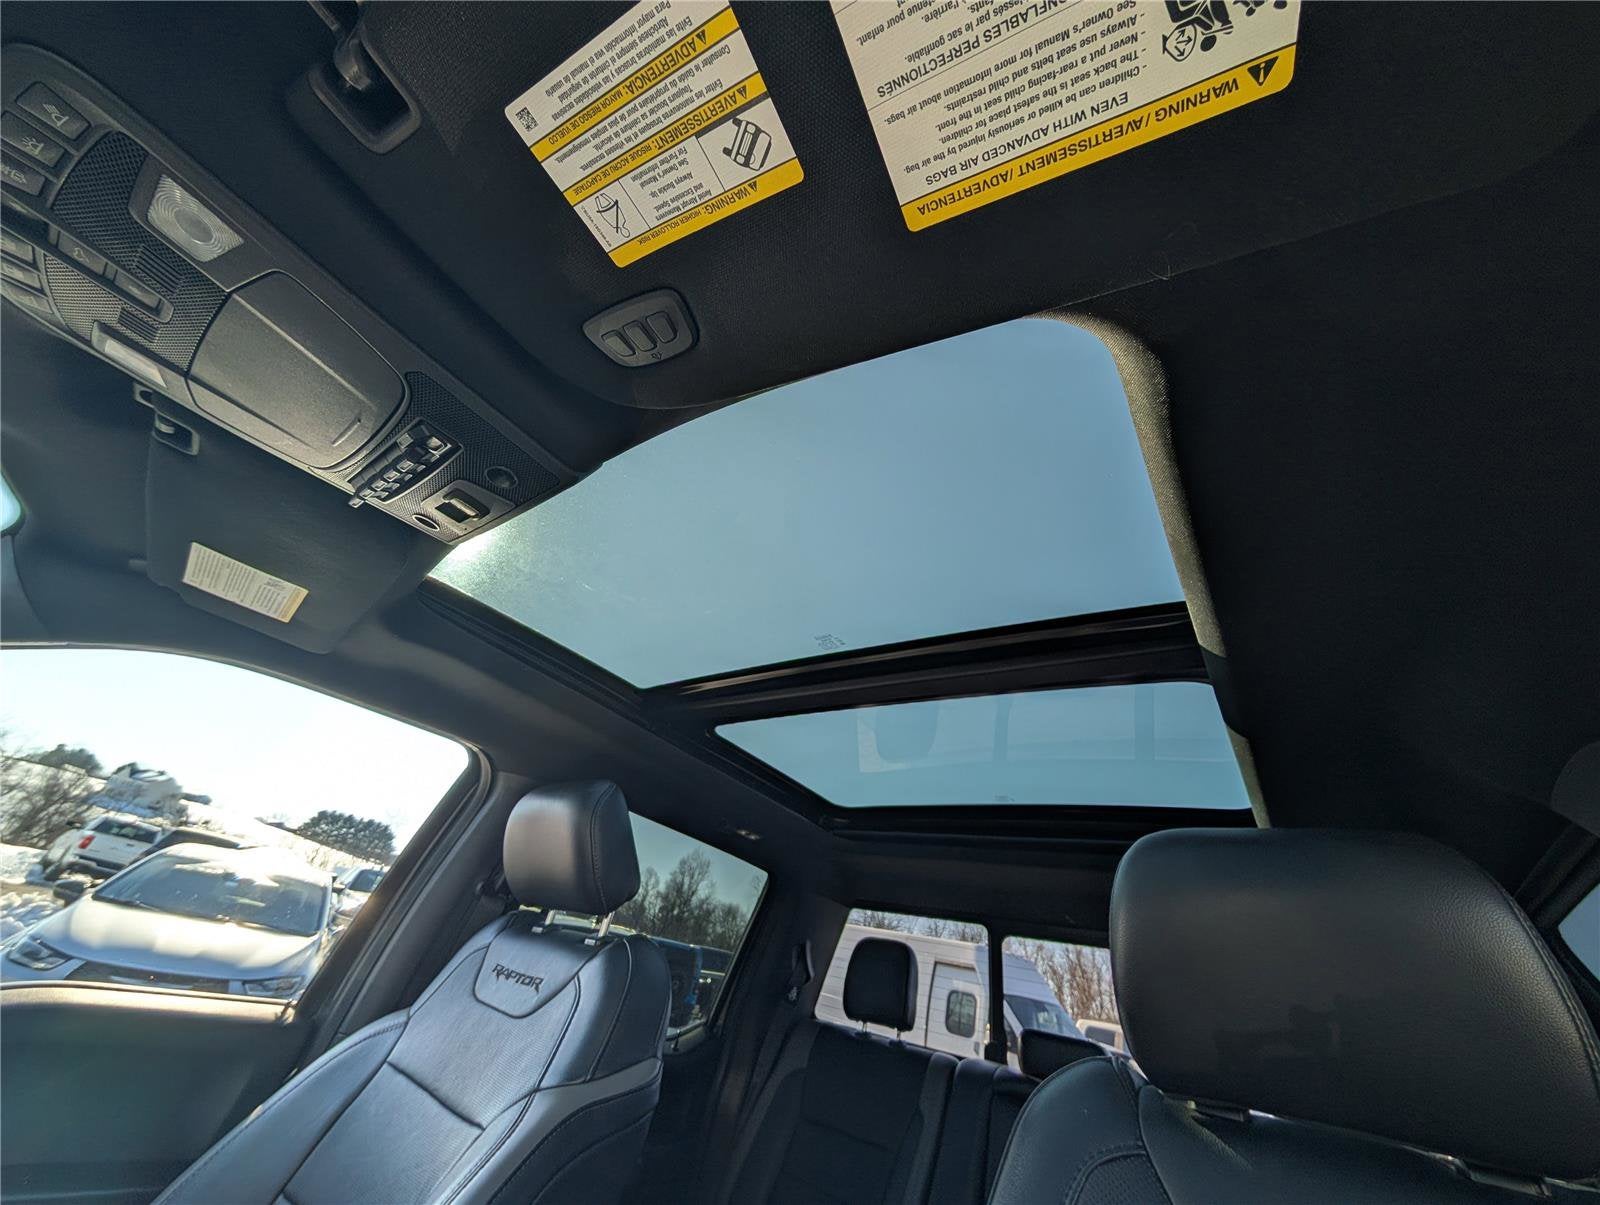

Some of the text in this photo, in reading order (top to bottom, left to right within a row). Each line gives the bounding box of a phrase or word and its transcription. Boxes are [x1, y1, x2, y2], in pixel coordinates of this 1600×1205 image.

[906, 0, 935, 16] tenue
[975, 9, 990, 27] par
[636, 9, 655, 28] mayor
[674, 15, 692, 31] Evite
[886, 9, 905, 29] pour
[964, 21, 973, 32] le
[1072, 7, 1113, 33] Owner's
[603, 23, 638, 52] información
[637, 15, 668, 43] Abróchese
[665, 27, 677, 39] las
[856, 23, 884, 46] enfant.
[946, 26, 962, 41] sac
[615, 38, 638, 59] siempre
[635, 34, 666, 60] maniobras
[904, 34, 945, 62] gonflable.
[1034, 28, 1070, 54] Manual
[593, 48, 605, 60] vea
[701, 44, 730, 68] Consulter
[943, 13, 1137, 111] Always use seat belts and child restraints.
[993, 54, 1017, 72] more
[1019, 46, 1032, 60] for
[569, 60, 589, 80] manual
[587, 59, 610, 80] cinturón
[614, 55, 638, 76] bruscas
[622, 37, 696, 94] ADVERTENCIA:
[676, 67, 695, 82] Guide
[876, 34, 980, 97] PERFECTIONNÉS
[601, 74, 612, 85] las
[704, 78, 722, 94] Éviter
[934, 31, 1138, 132] Never put a rear-facing child seat in the front.
[943, 67, 992, 96] information
[557, 80, 582, 104] seguridad
[573, 80, 603, 105] velocidades
[599, 88, 623, 108] MAYOR
[637, 82, 669, 109] propriétaire
[667, 83, 693, 103] Toujours
[694, 89, 705, 99] les
[917, 92, 941, 110] about
[938, 49, 1138, 144] The back seat is the safest place for children.
[1154, 77, 1238, 121] WARNING
[577, 103, 601, 124] RIESGO
[625, 102, 639, 117] pour
[647, 98, 669, 116] boucler
[883, 110, 905, 124] bags.
[906, 104, 917, 115] air
[606, 115, 619, 129] plus
[619, 116, 641, 134] ceinture
[637, 116, 663, 135] brusques
[651, 90, 737, 150] AVERTISSEMENT:
[903, 65, 1139, 173] Children can be killed or seriously injured by the air bag.
[548, 125, 572, 144] VUELCO
[589, 124, 608, 140] amples
[623, 134, 634, 143] les
[925, 91, 1128, 185] EVEN WITH ADVANCED AIR BAGS
[628, 143, 652, 161] RISQUE
[609, 156, 629, 173] ACCRU
[630, 145, 687, 182] For Further Information
[639, 157, 688, 189] See Owner's Manual
[572, 173, 602, 195] CAPOTAGE
[656, 180, 675, 194] Buckle
[673, 171, 693, 185] Always
[692, 182, 703, 192] and
[655, 188, 712, 221] Avoid Abrupt Maneuvers
[669, 187, 694, 204] Excessive
[636, 186, 750, 245] WARNING: HIGHER ROLLOVER RISK
[492, 963, 544, 993] RAPTOR
